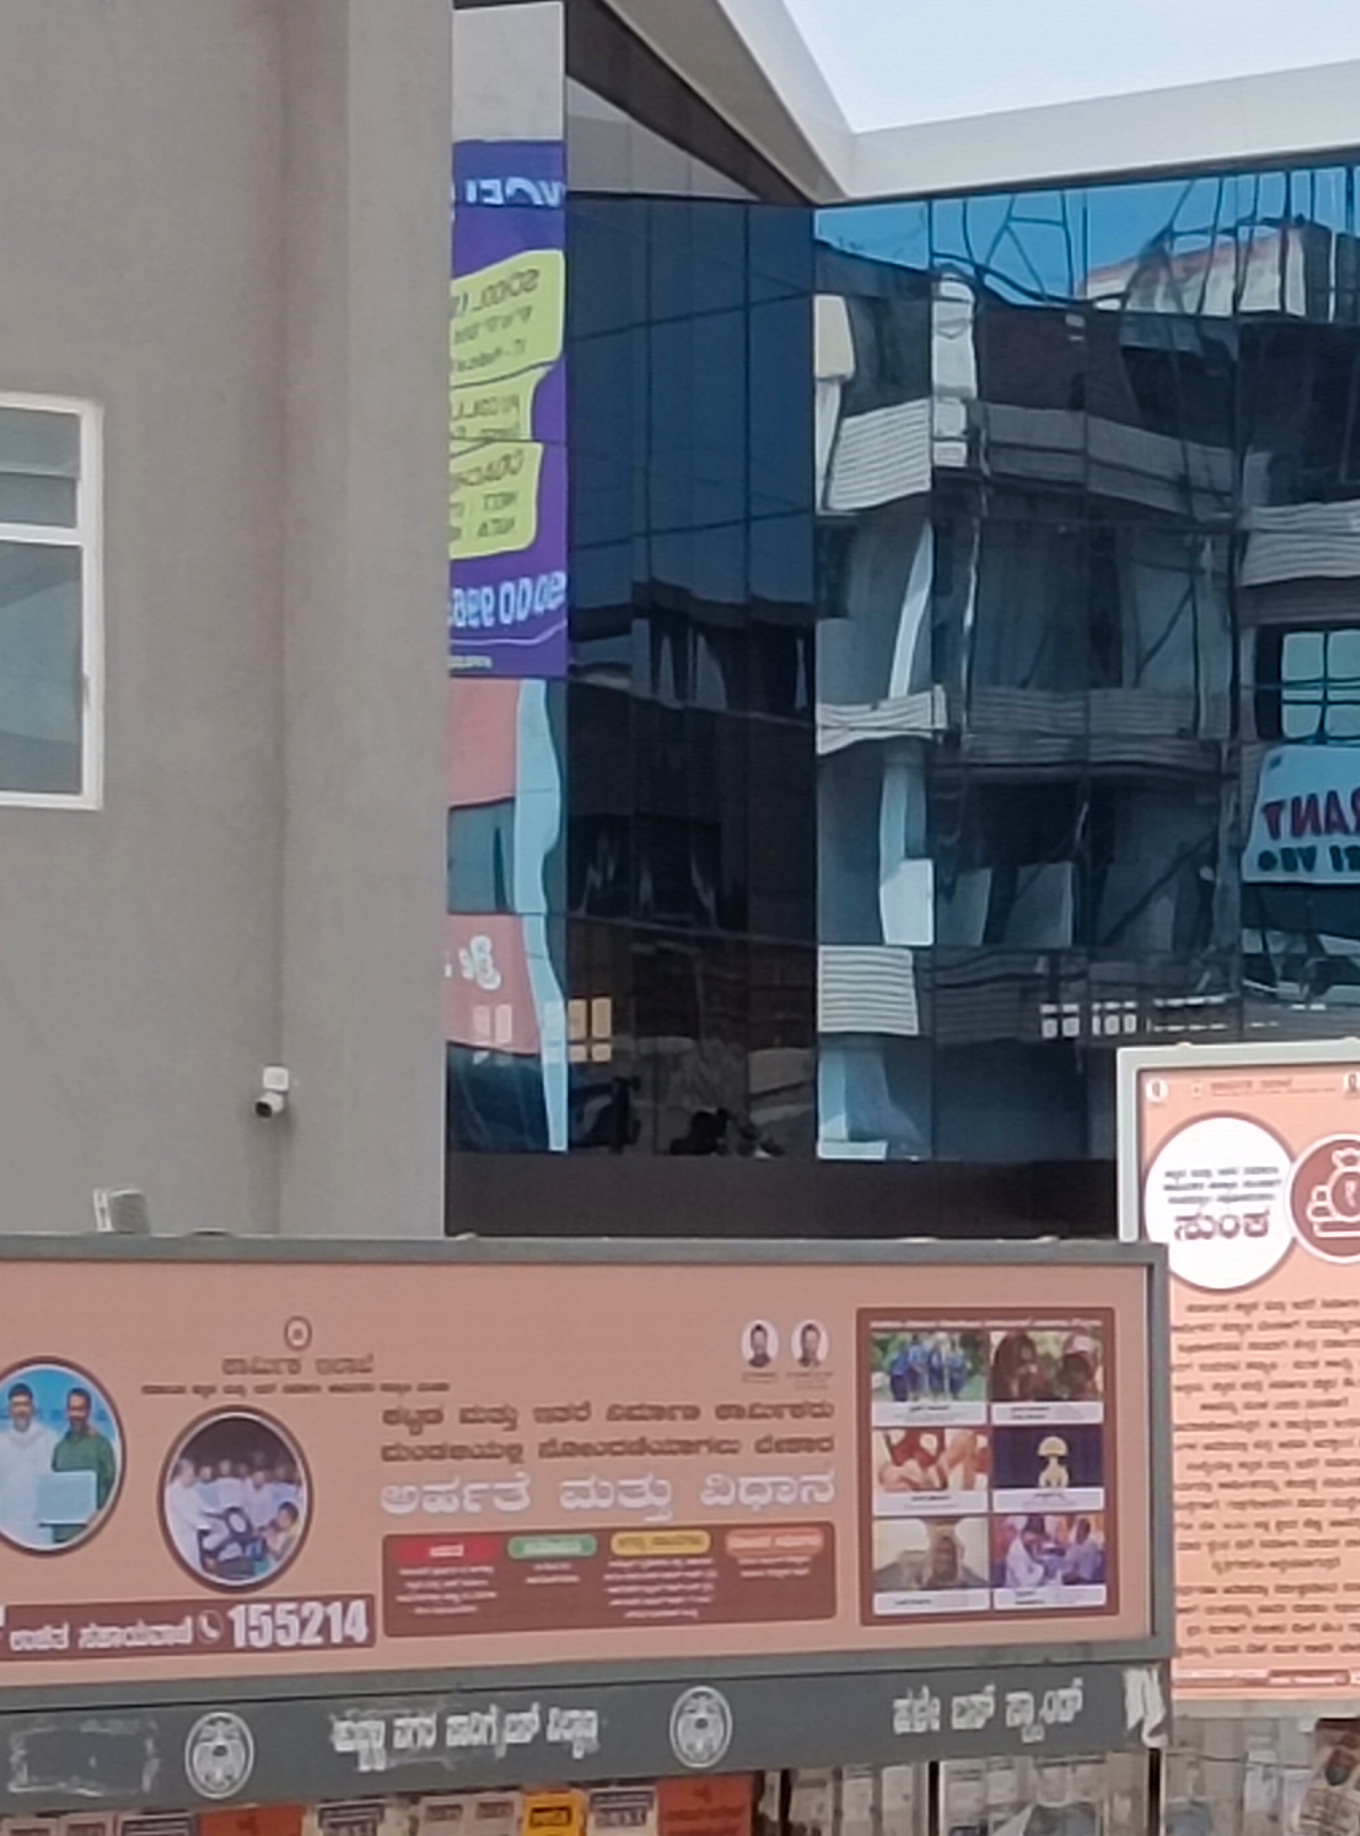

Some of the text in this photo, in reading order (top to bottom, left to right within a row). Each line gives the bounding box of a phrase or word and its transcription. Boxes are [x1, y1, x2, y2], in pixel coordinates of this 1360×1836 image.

[380, 1466, 836, 1522] ಅರ್ಹತೆ ಮತ್ತು ವಿಧಾನ
[228, 1599, 369, 1649] 155214
